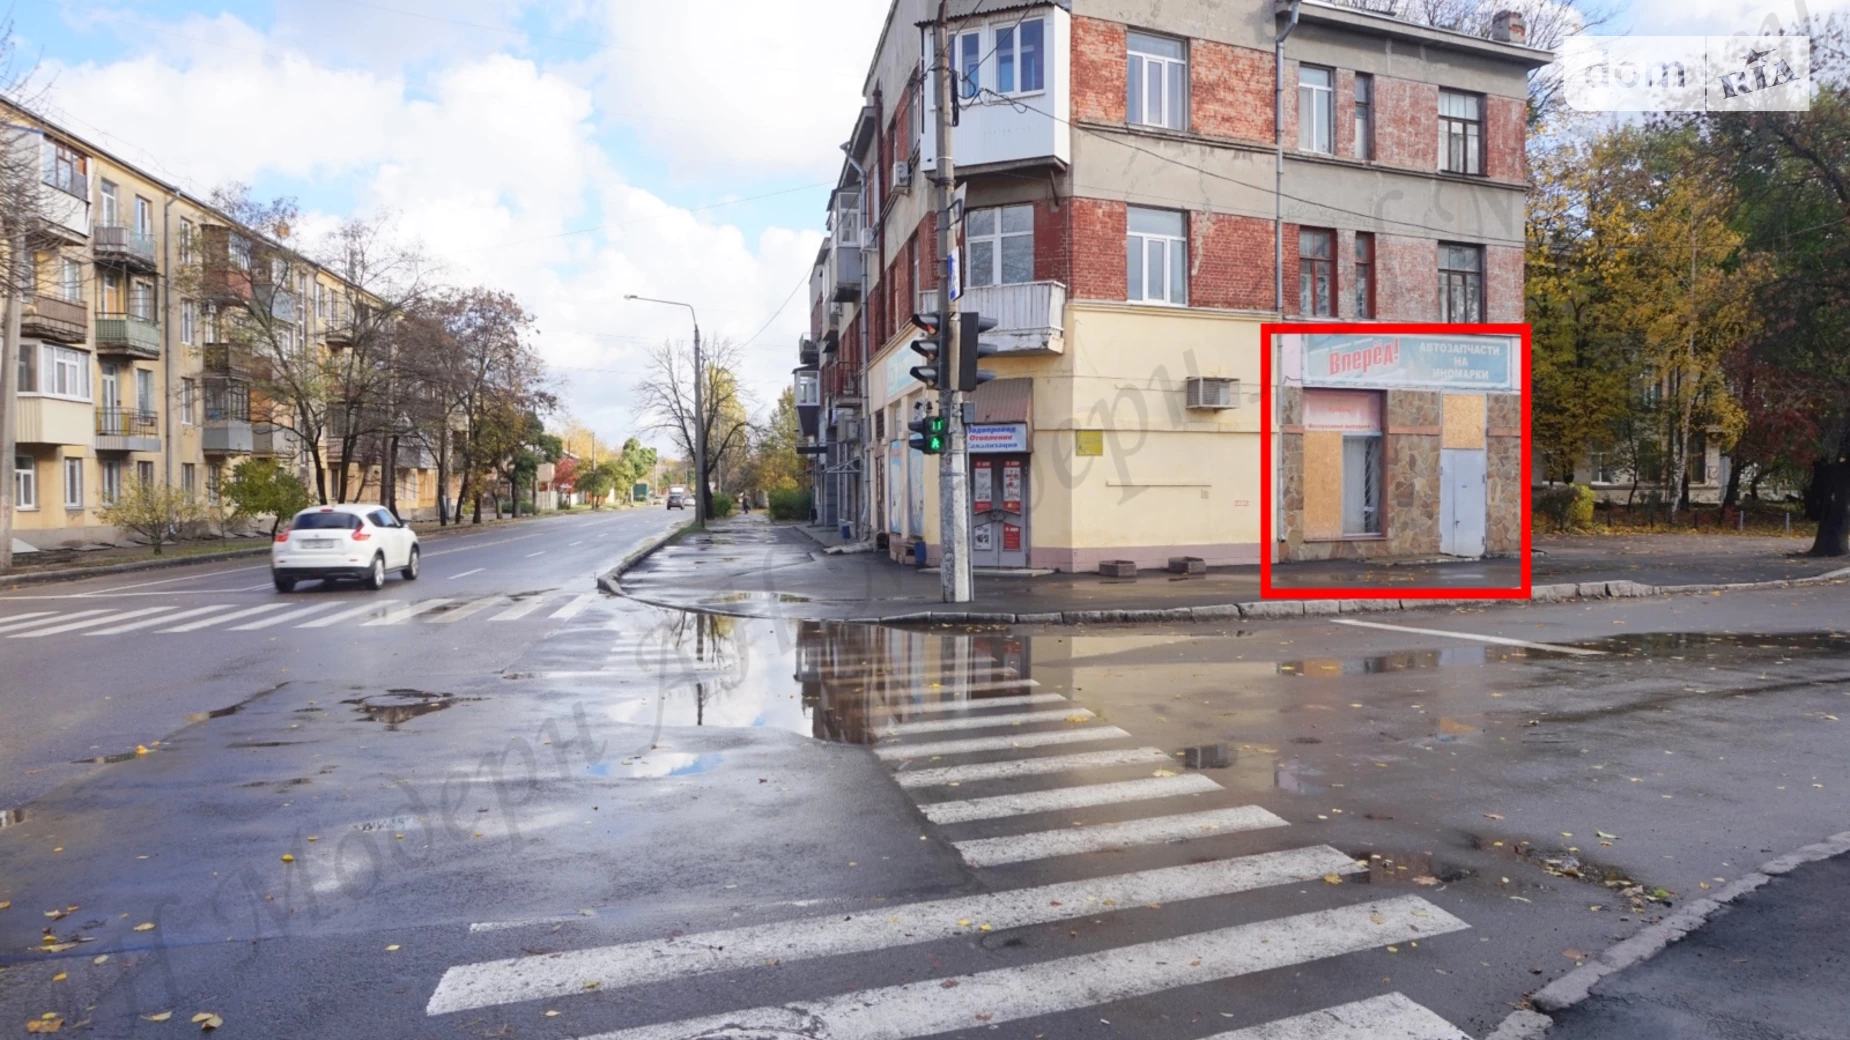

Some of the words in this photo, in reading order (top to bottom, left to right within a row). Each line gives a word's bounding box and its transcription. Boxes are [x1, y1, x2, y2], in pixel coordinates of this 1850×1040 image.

[1420, 341, 1501, 356] АВТОЗАПЧАСТИ
[1329, 338, 1399, 375] Вперёд!
[1453, 356, 1469, 366] НА
[1432, 368, 1489, 380] ИНОМАРКИ
[969, 434, 1013, 442] Отопление
